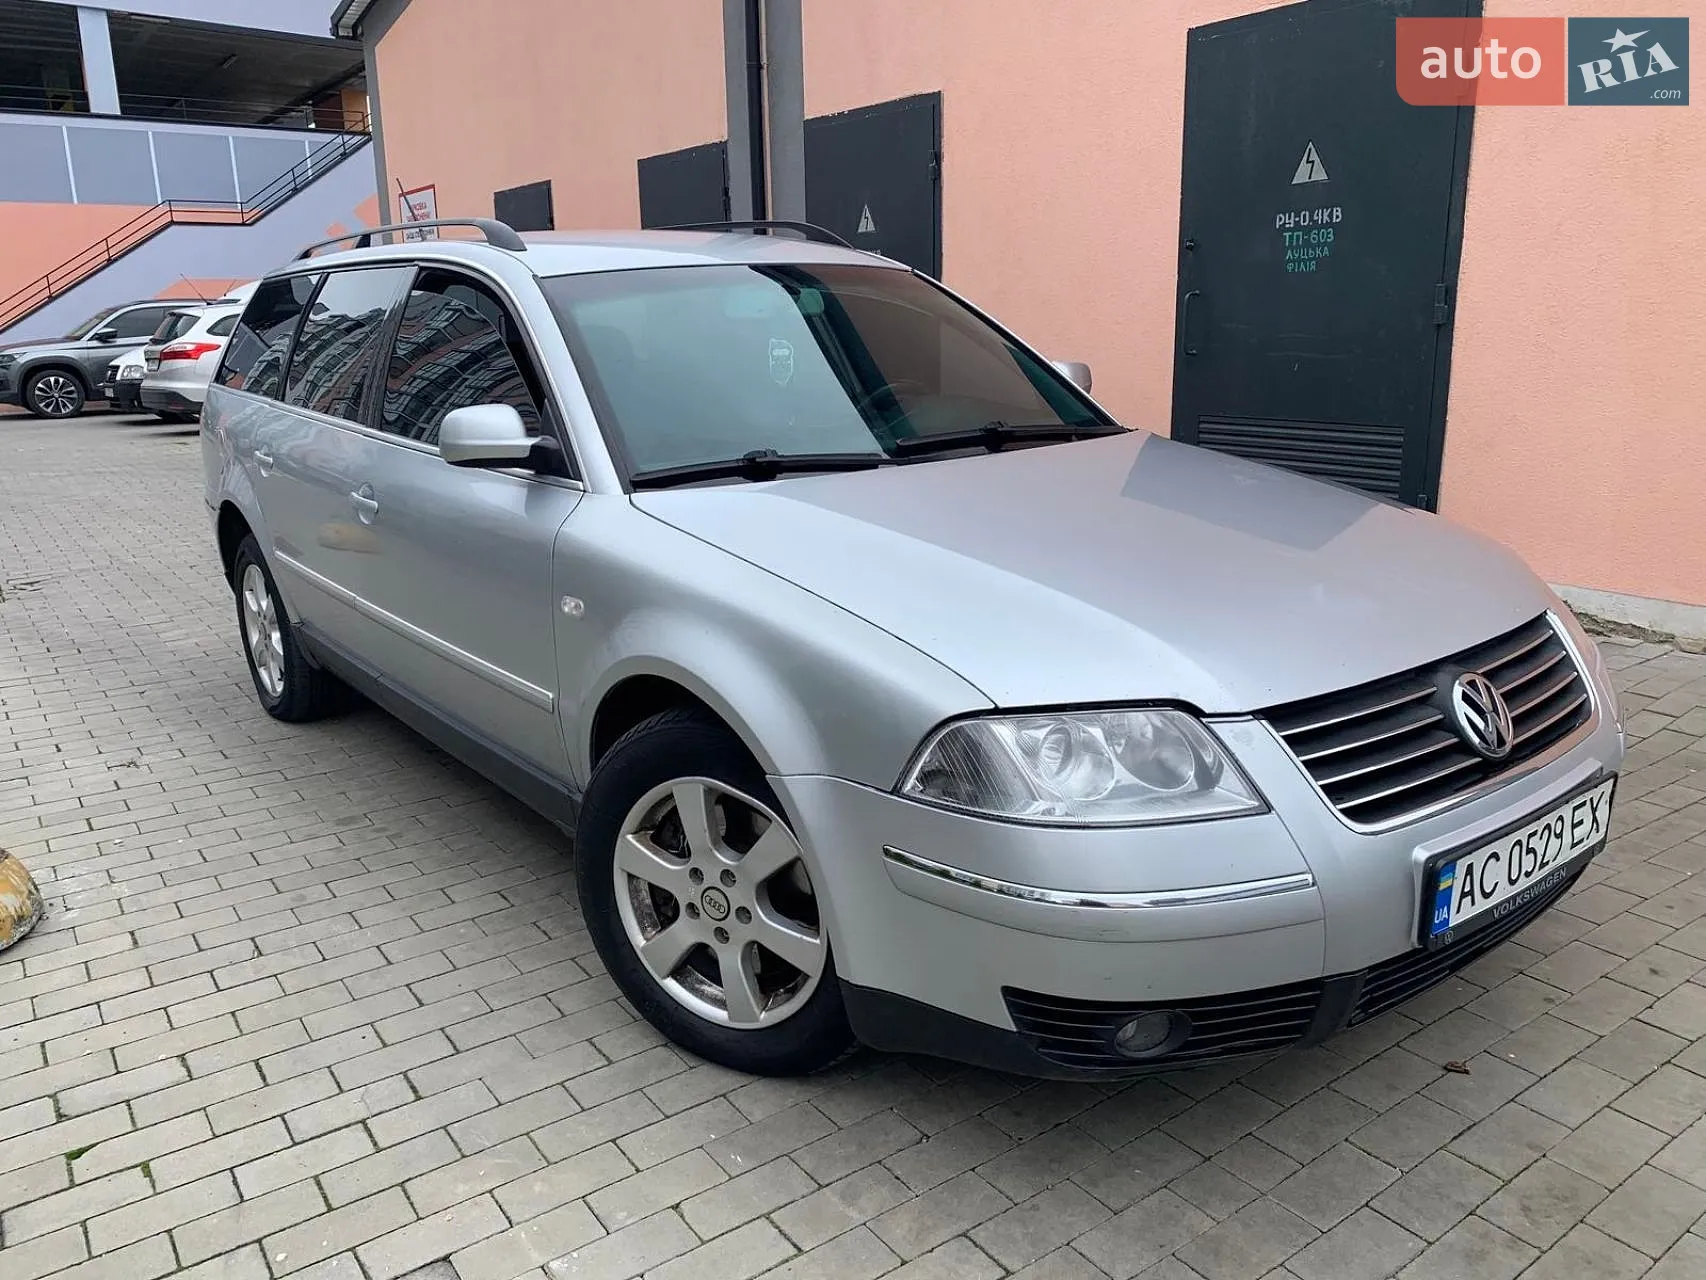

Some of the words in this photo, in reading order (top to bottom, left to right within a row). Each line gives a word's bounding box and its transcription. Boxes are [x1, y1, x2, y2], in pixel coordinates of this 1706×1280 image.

[1283, 228, 1334, 247] ТП-603
[1285, 247, 1330, 261] ЛУЦЬКА
[1456, 851, 1501, 915] AC
[1507, 814, 1565, 886] 0529
[1570, 791, 1605, 850] EX
[1492, 866, 1567, 920] VOLKSWAGEN
[1434, 904, 1449, 924] UA
